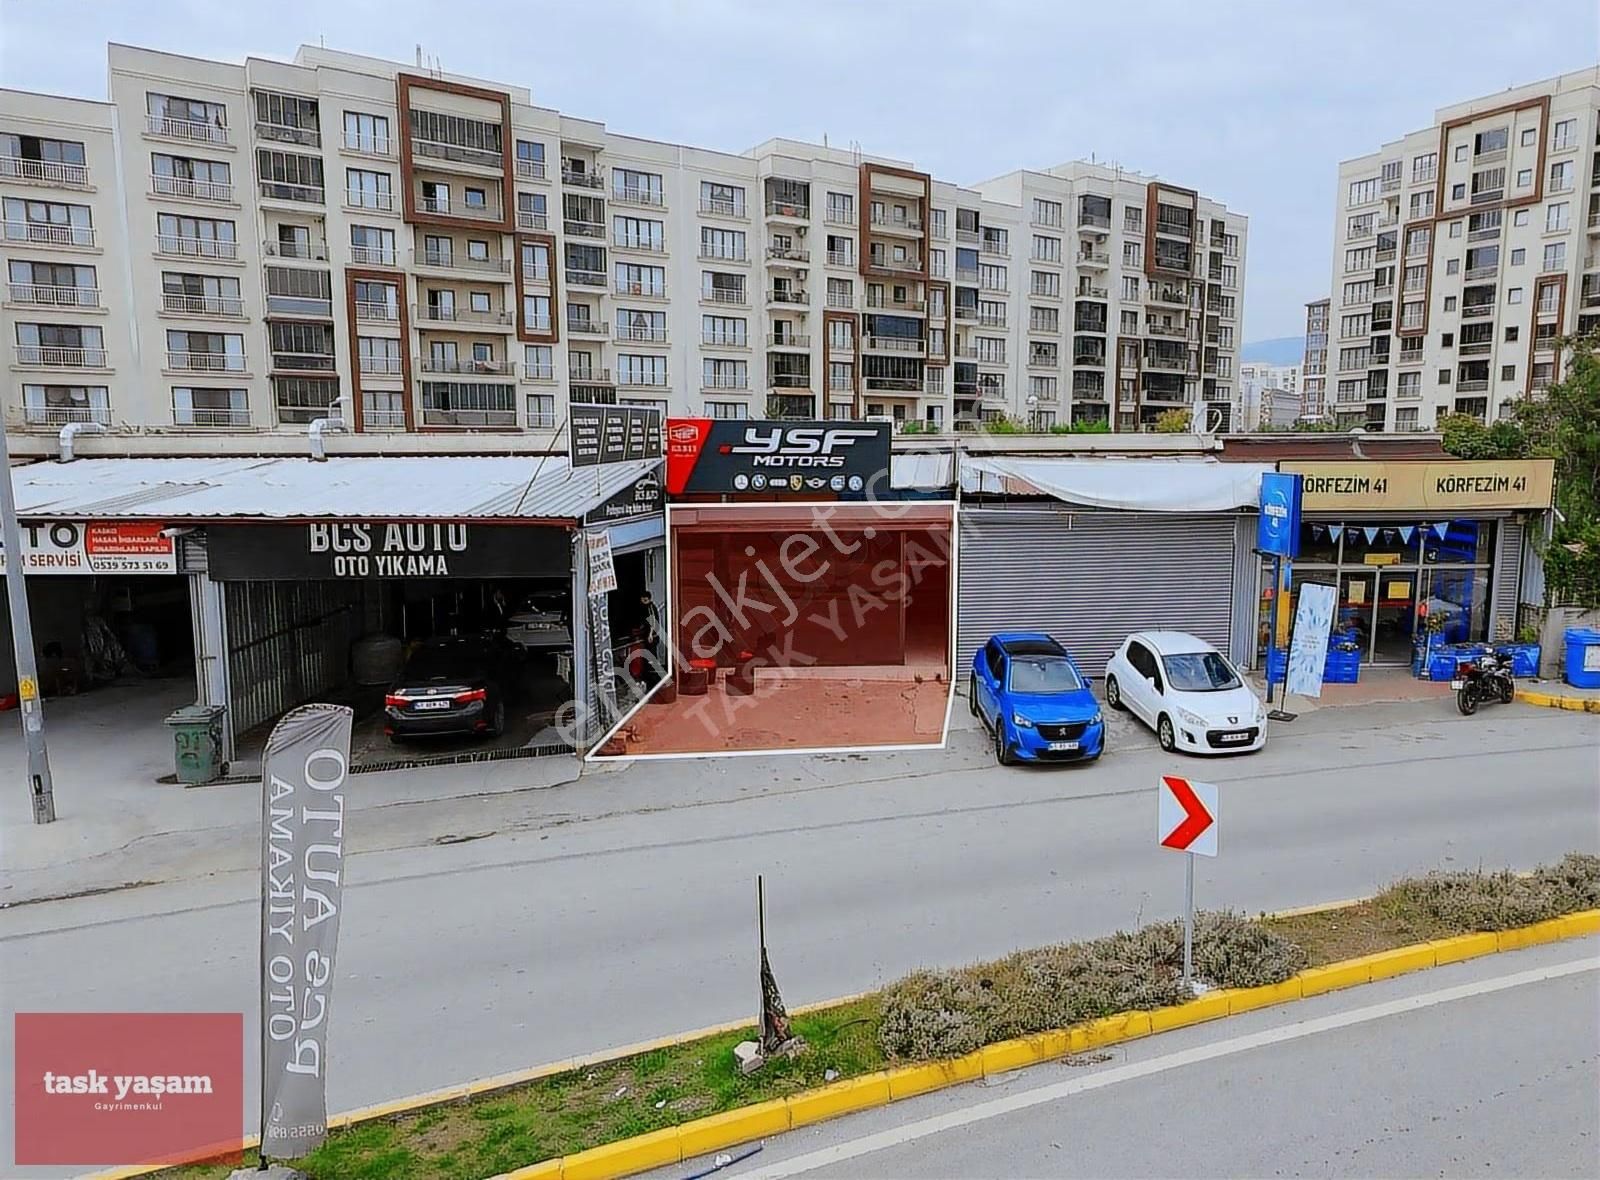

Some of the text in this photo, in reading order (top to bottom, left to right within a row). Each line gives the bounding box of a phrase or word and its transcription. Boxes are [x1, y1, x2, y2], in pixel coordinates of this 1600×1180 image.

[732, 428, 877, 454] YSF
[752, 456, 845, 467] MOTORS
[1372, 477, 1388, 493] 41
[1437, 473, 1527, 492] KÖRFEZİM 41
[30, 551, 81, 567] SERVİSİ
[334, 555, 449, 577] OTO YIKAMA
